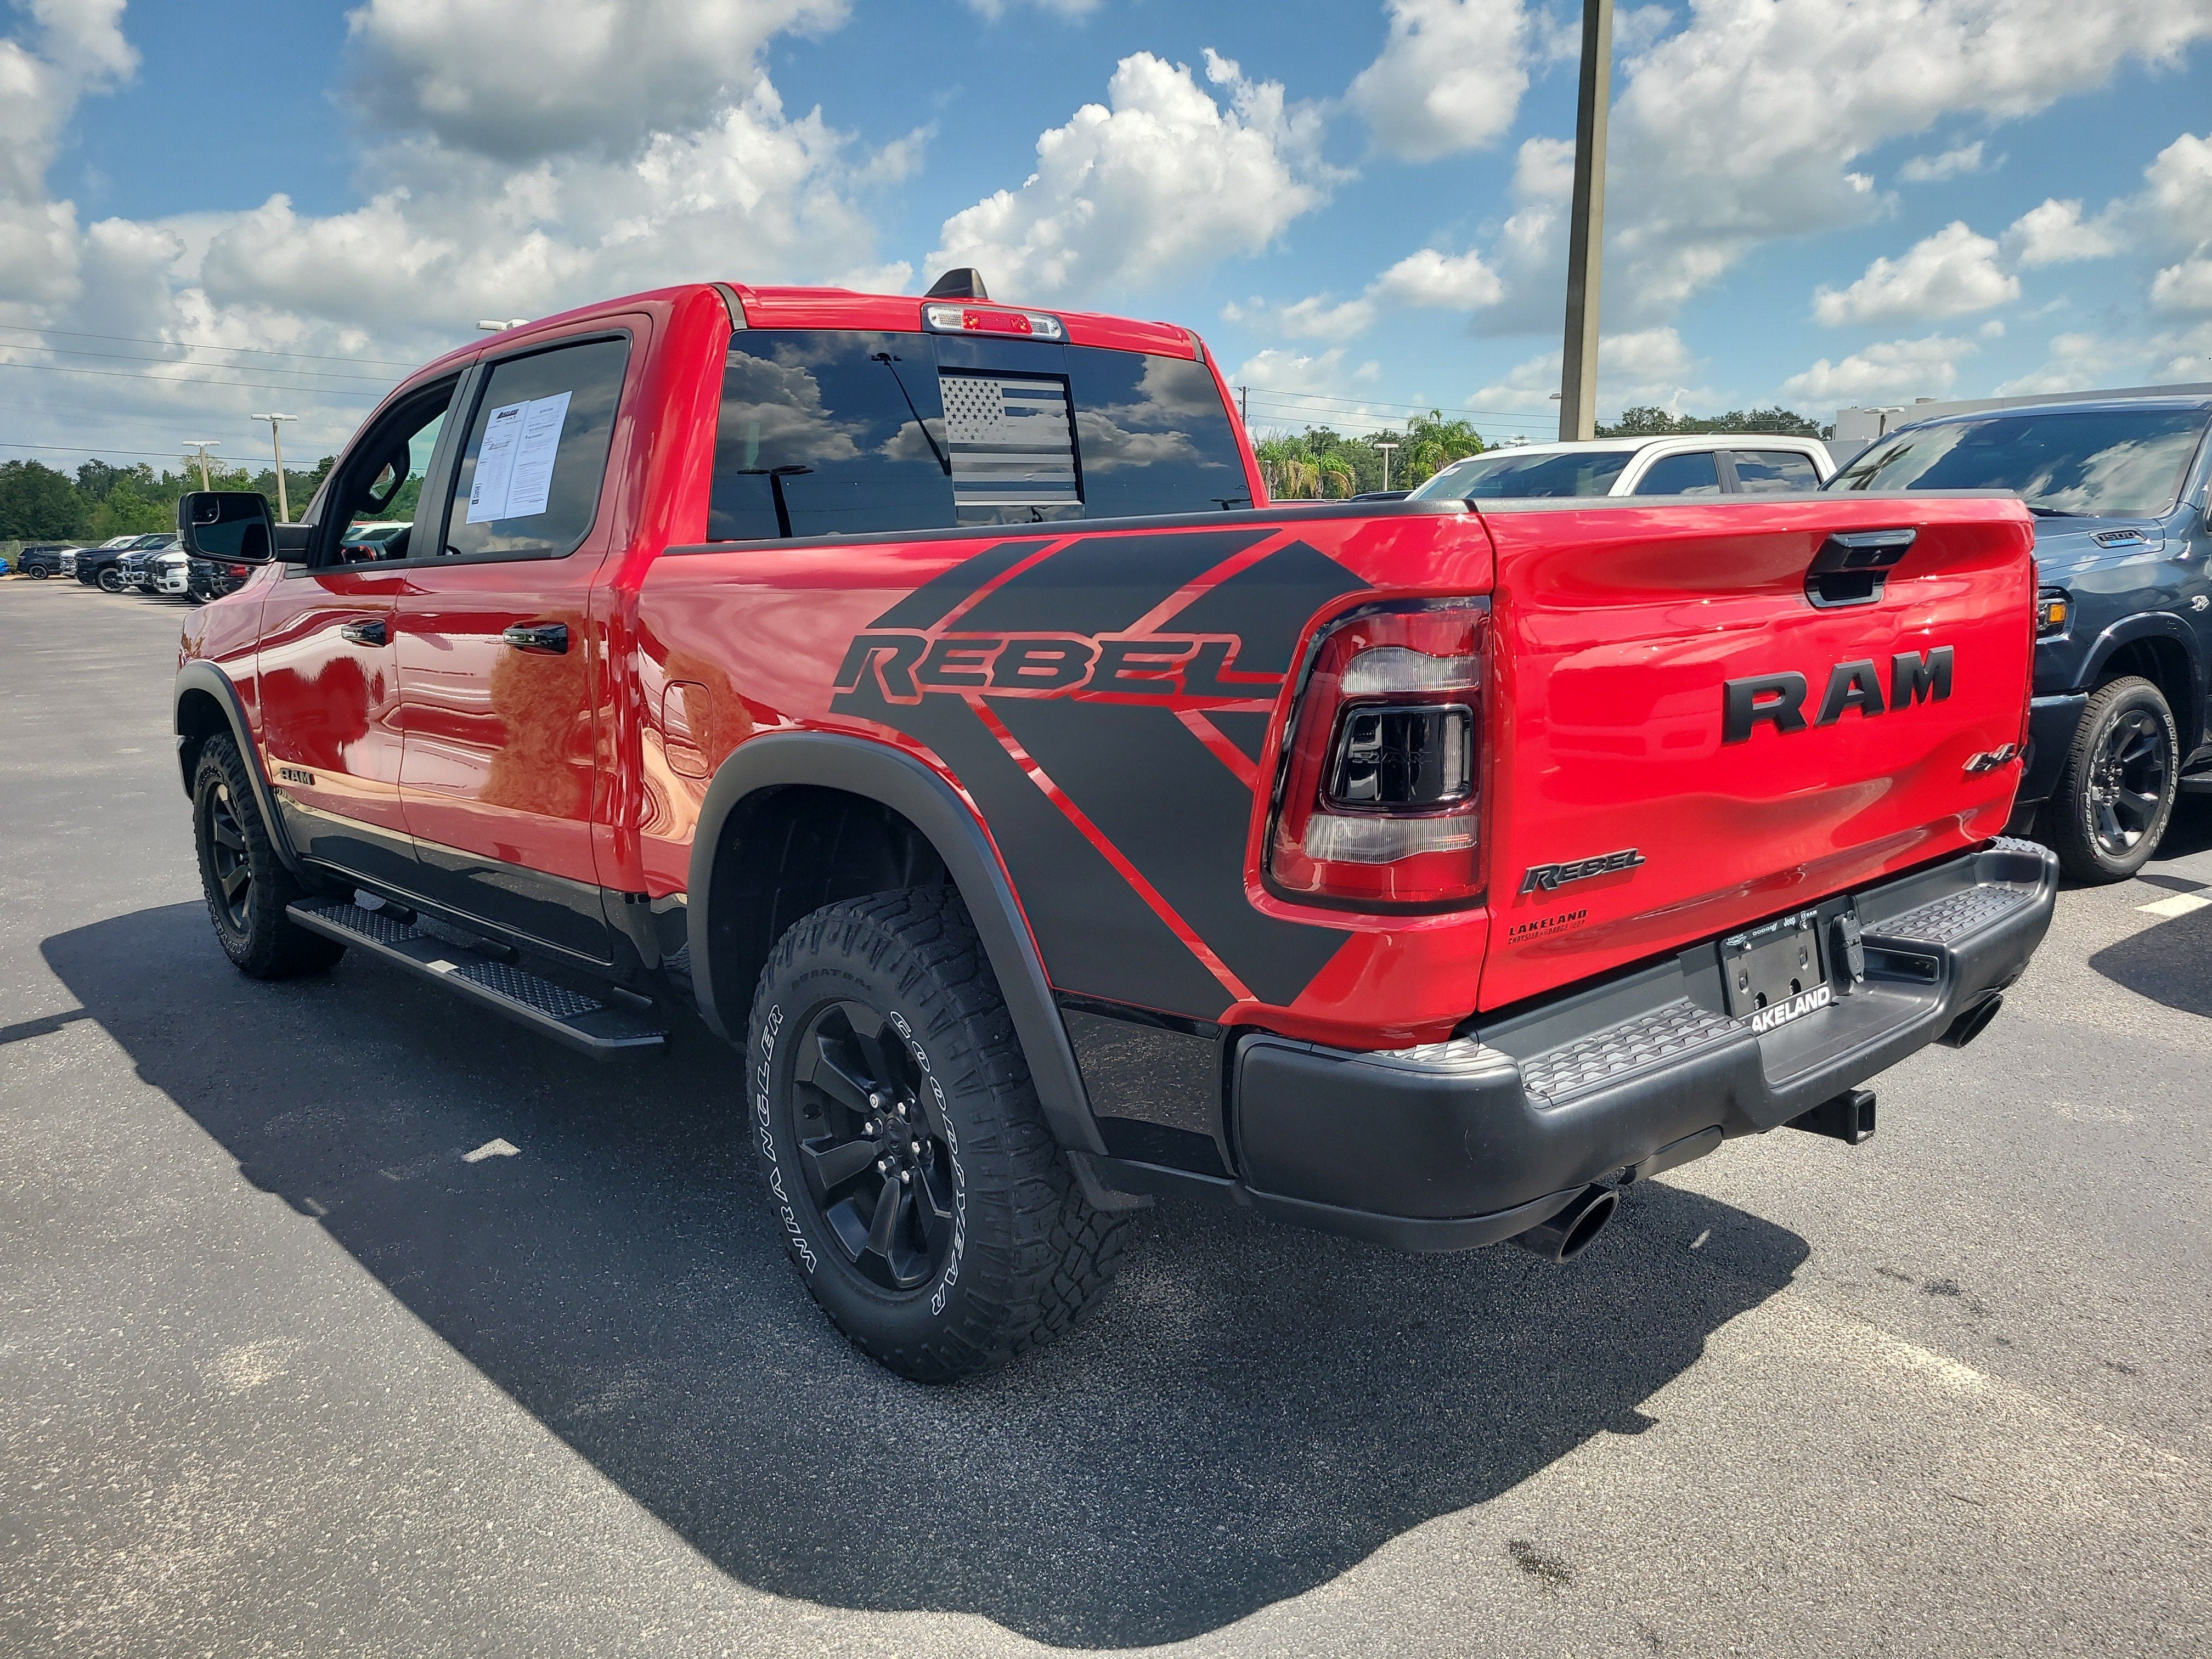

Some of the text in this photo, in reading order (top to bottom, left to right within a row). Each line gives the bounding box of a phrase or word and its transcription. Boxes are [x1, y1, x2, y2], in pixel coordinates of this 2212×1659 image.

[2097, 531, 2136, 541] 1500
[832, 634, 1284, 704] REBEL
[1722, 645, 1954, 744] RAM
[280, 768, 315, 786] RAM
[2163, 713, 2178, 805] DUELER
[1520, 847, 1646, 894] REBEL
[1509, 909, 1588, 936] LAKELAND
[1783, 916, 1796, 928] Jeep
[1806, 909, 1818, 917] RAM
[1745, 986, 1831, 1035] AKELAND
[756, 1003, 818, 1274] WRANGLER
[890, 1010, 968, 1316] GOODYEAR
